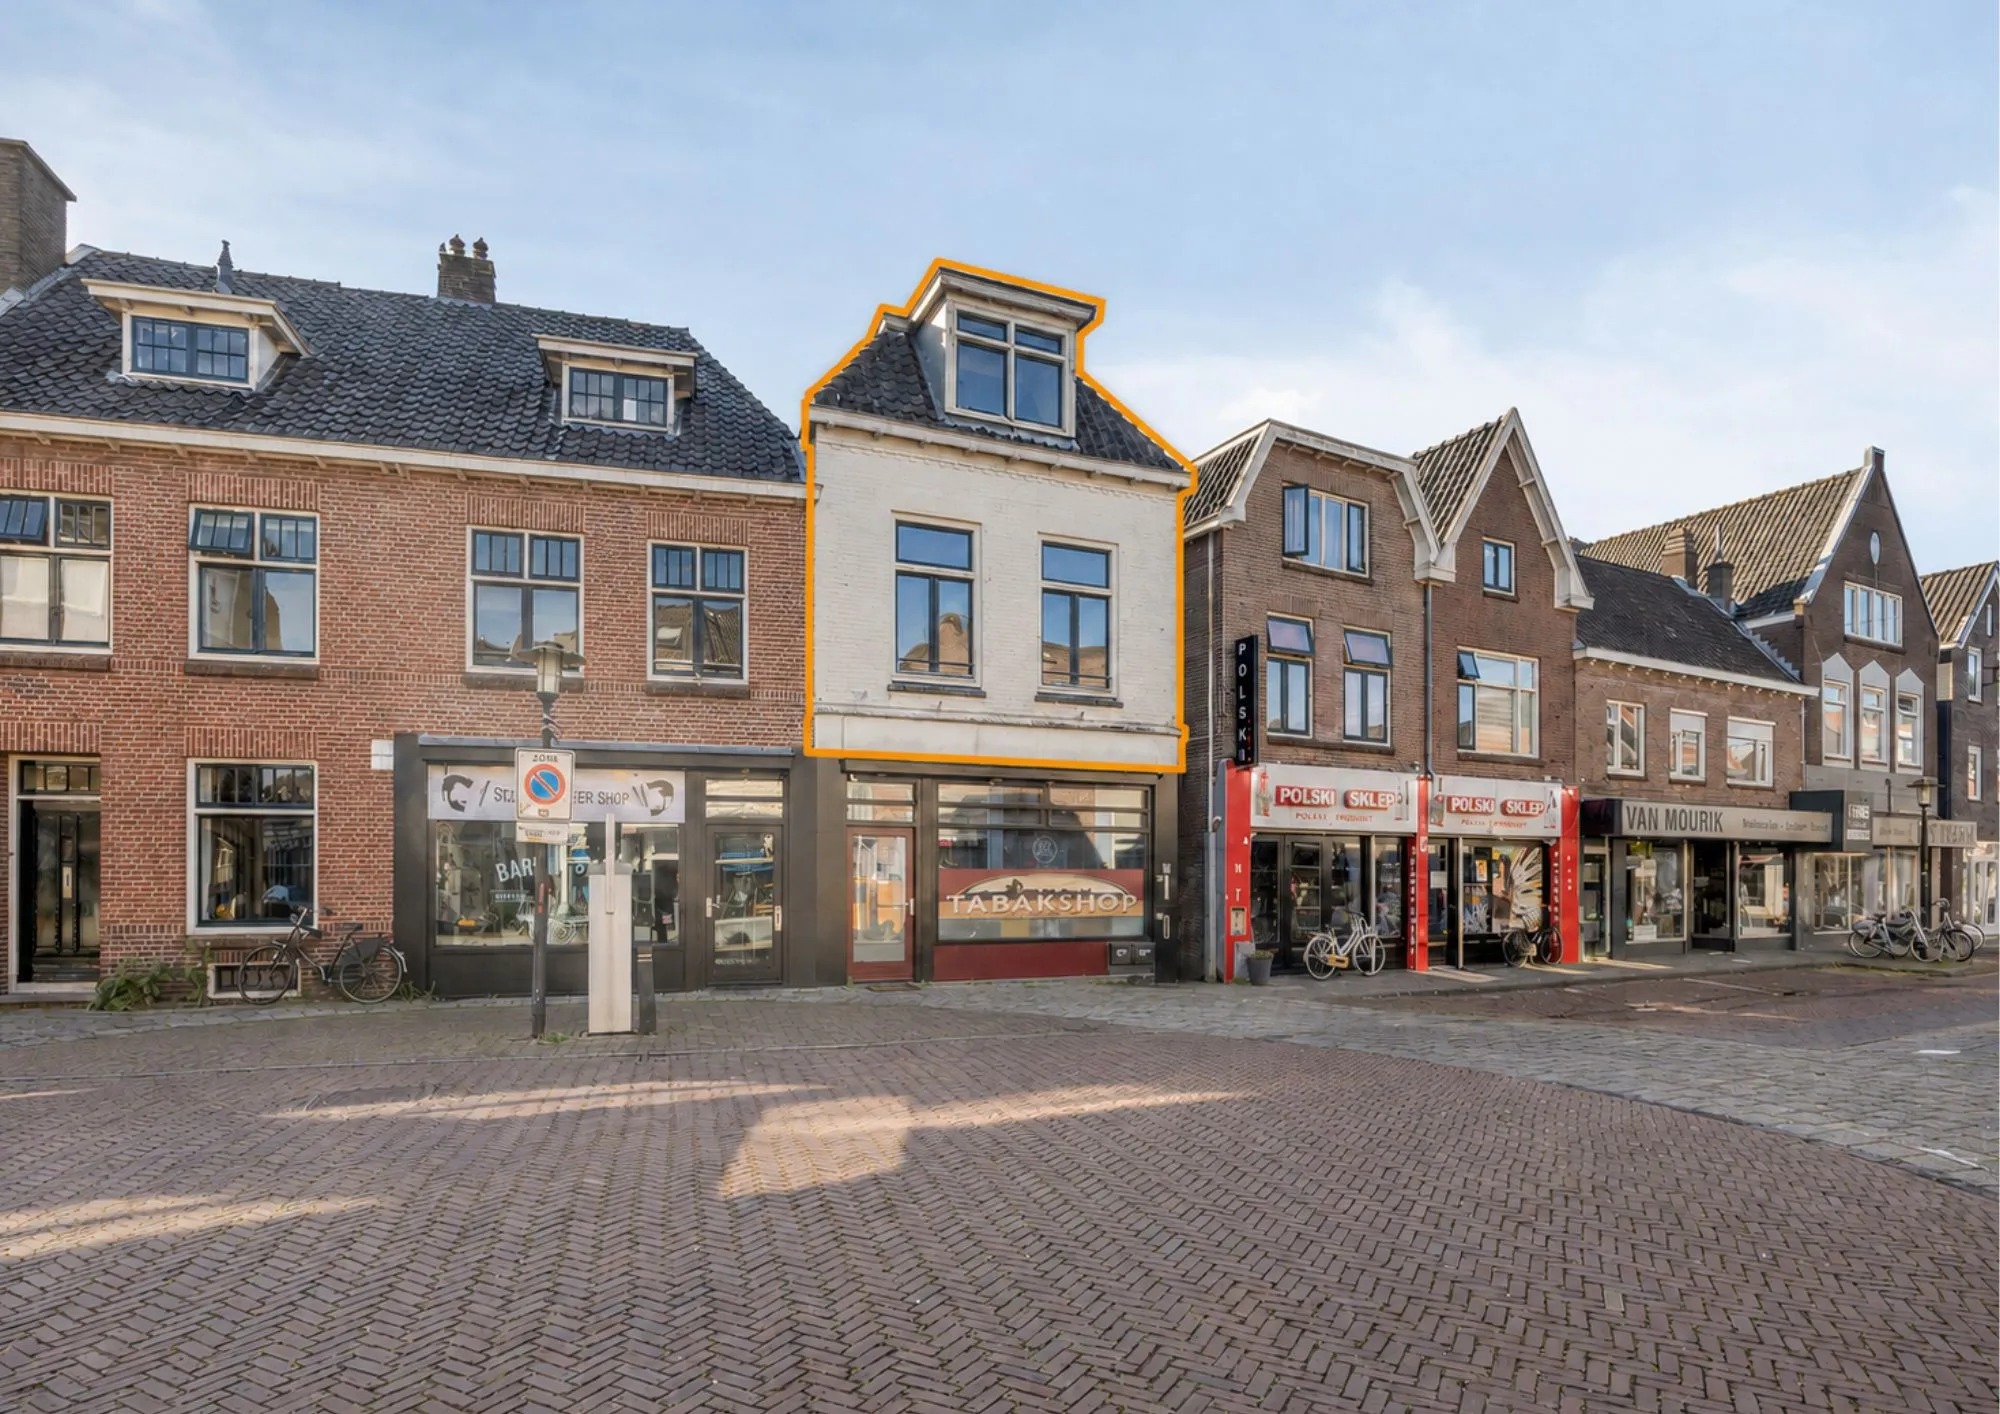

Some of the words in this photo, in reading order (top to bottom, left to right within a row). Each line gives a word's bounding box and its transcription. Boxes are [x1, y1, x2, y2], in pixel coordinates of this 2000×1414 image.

[1238, 642, 1248, 762] POLSKI
[597, 790, 630, 806] SHOP
[1279, 787, 1336, 806] POLSKI
[1349, 790, 1396, 808] SKLEP
[1451, 797, 1495, 813] POLSKI
[1505, 800, 1545, 815] SKLEP
[1626, 805, 1659, 831] VAN
[1664, 808, 1724, 833] MOURIK
[945, 893, 1138, 915] TABAKSHOP
